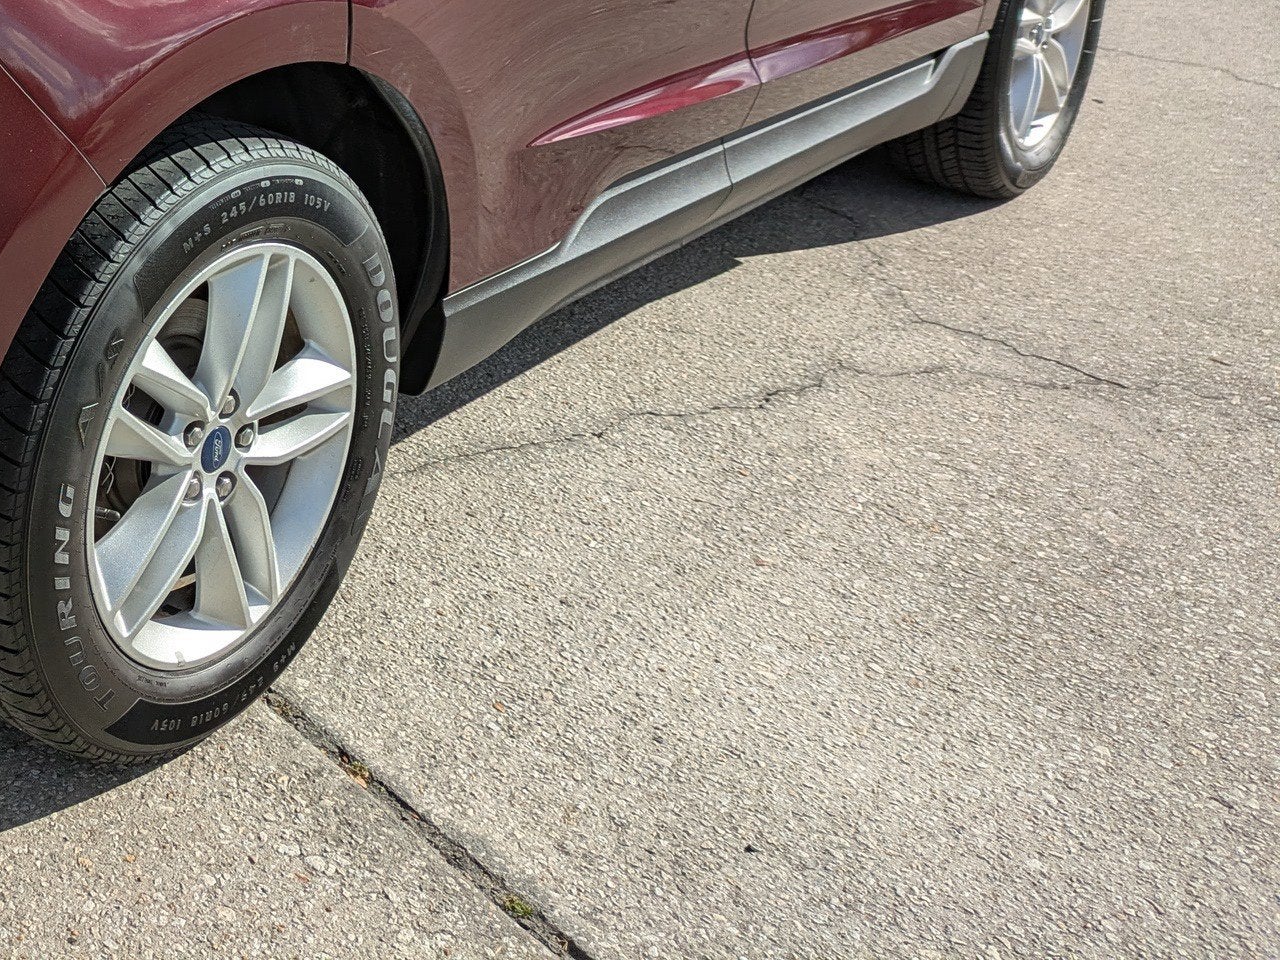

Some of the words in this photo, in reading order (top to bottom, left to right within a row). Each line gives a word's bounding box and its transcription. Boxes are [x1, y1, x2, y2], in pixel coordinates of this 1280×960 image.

[220, 191, 296, 225] 245/60R18
[303, 193, 331, 212] 105V
[54, 483, 116, 711] TOURING
